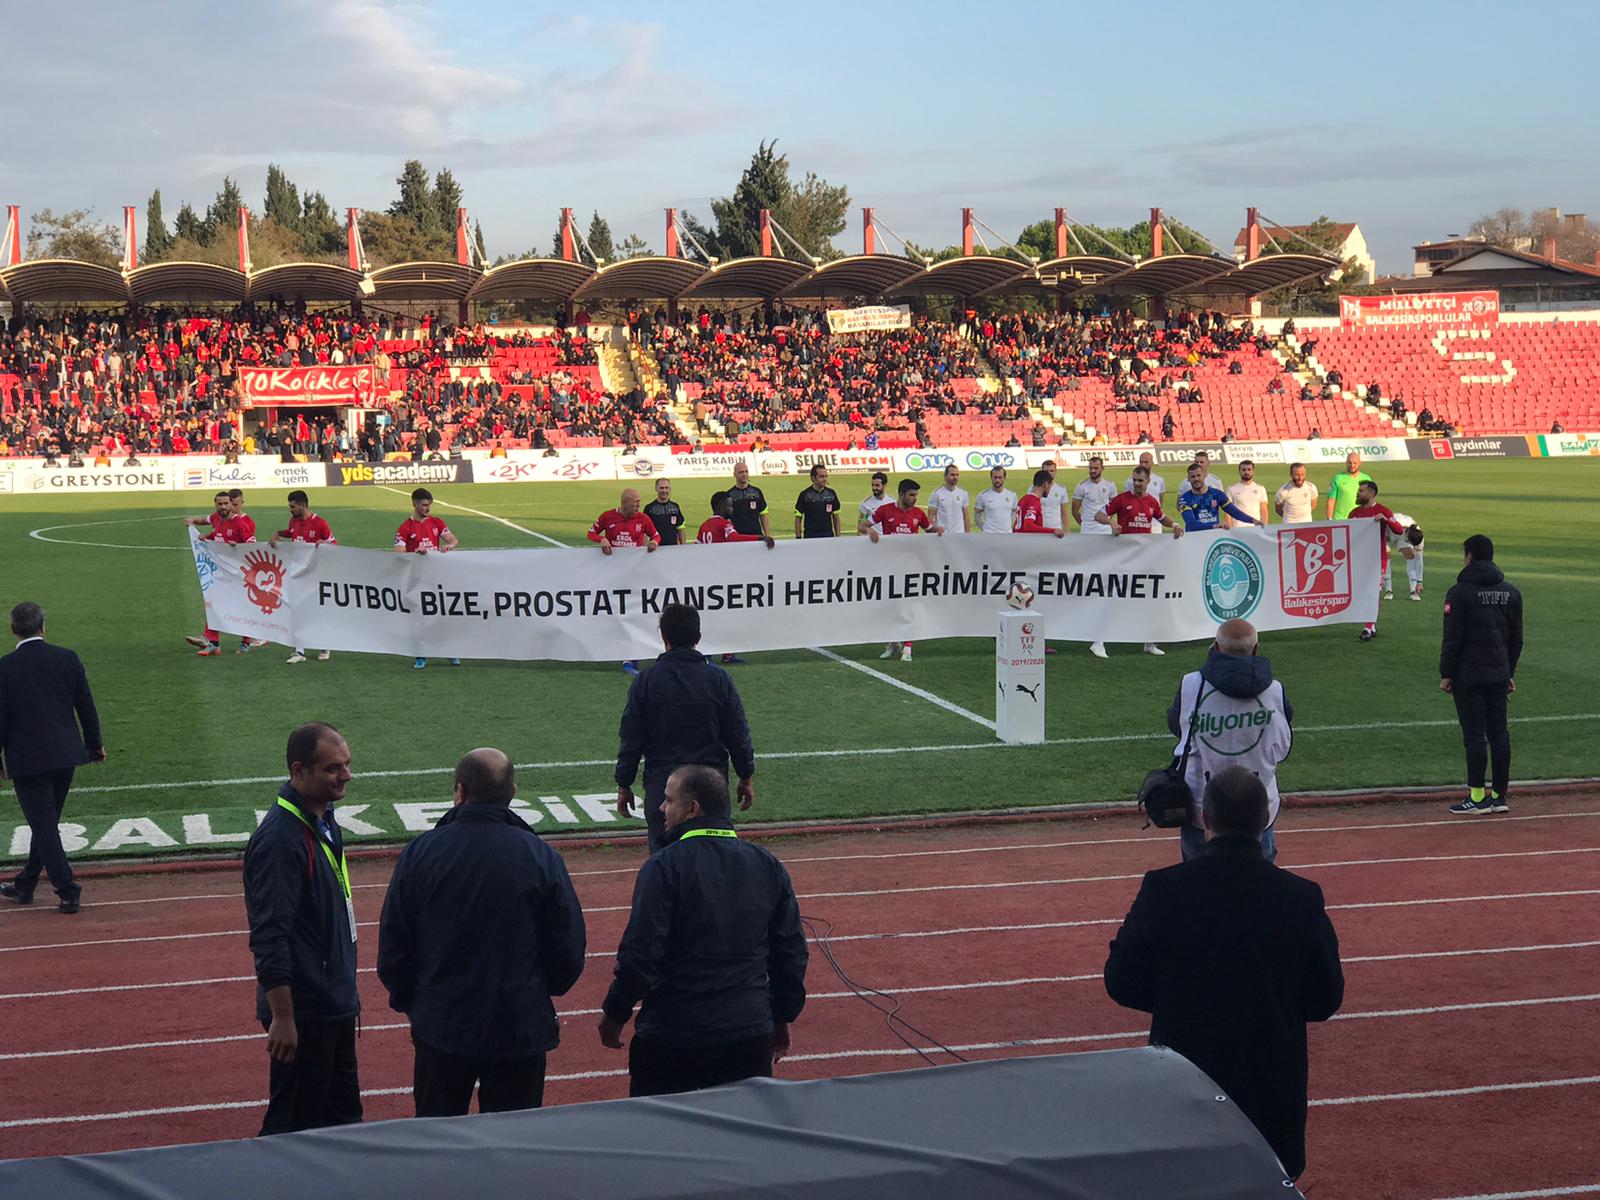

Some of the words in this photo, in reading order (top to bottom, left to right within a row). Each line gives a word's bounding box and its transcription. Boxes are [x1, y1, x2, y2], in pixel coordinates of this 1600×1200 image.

[1453, 439, 1502, 452] aydınlar
[840, 456, 889, 465] BETON
[1113, 451, 1136, 461] YAPI
[1159, 448, 1223, 462] mesar
[677, 457, 710, 467] YARIŞ
[50, 473, 166, 487] GREYSTONE
[209, 468, 256, 481] Kula
[341, 463, 458, 485] ydsacademy
[319, 581, 410, 613] FUTBOL
[421, 584, 489, 619] BİZE,
[494, 589, 631, 617] PROSTAT
[641, 575, 774, 614] KANSERİ
[1304, 606, 1329, 616] 1966
[1188, 709, 1276, 738] Bilyoner
[8, 793, 646, 857] BALKESİR
